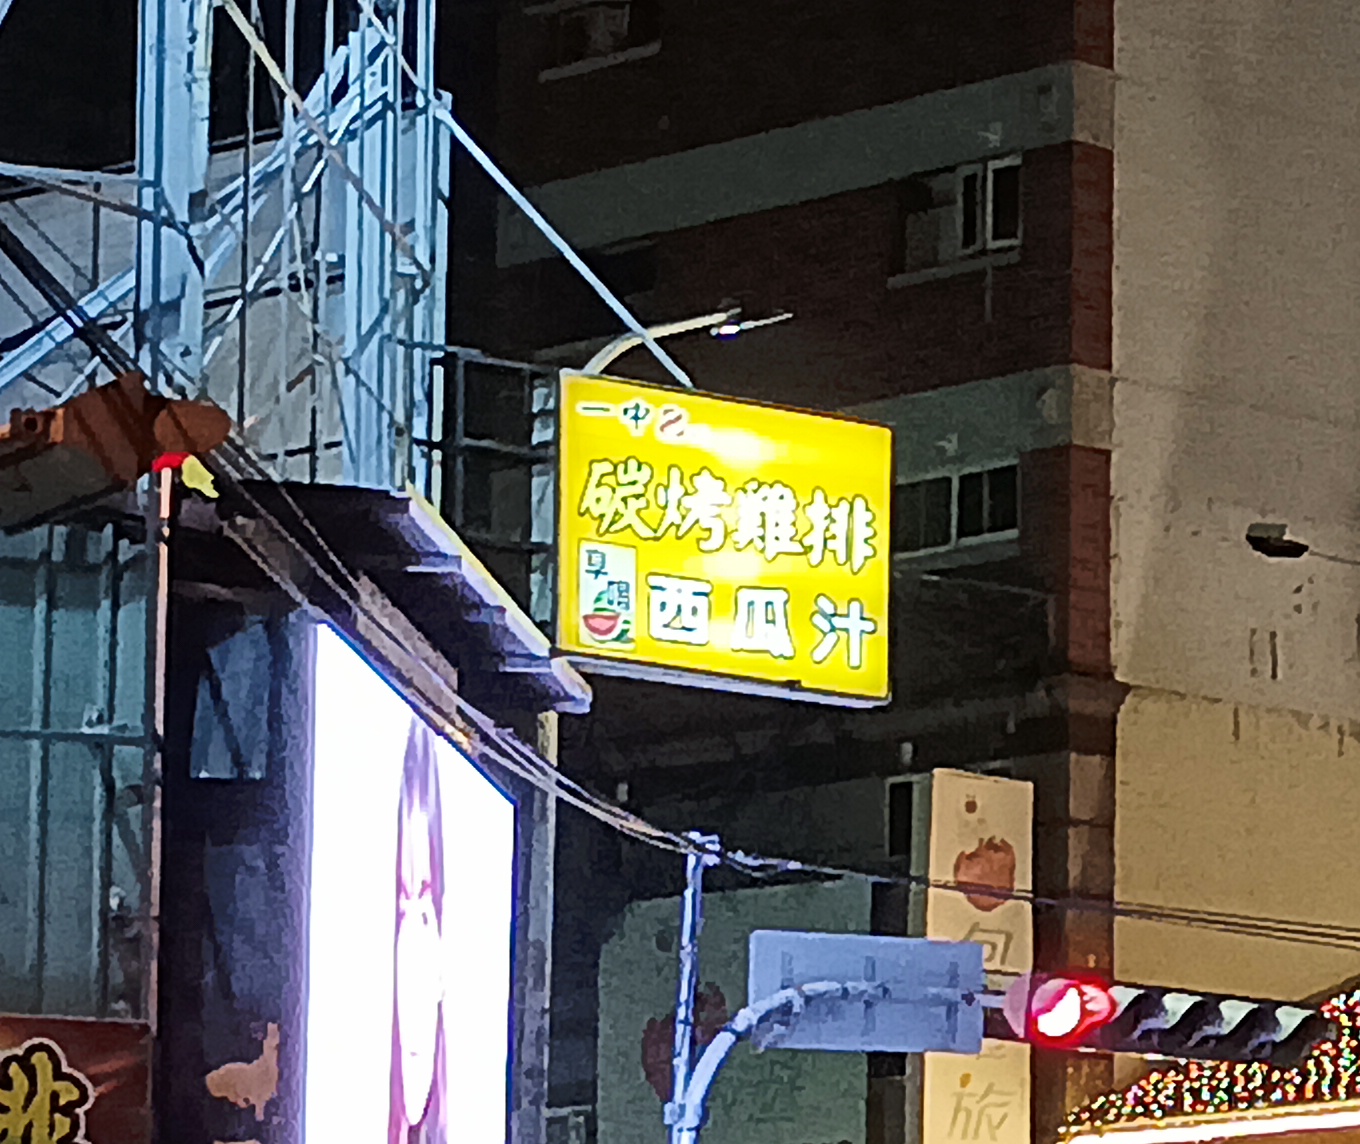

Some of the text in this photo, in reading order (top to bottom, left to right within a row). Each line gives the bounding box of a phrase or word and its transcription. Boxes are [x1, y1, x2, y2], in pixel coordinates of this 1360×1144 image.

[578, 456, 877, 575] 碳烤雞排
[646, 572, 877, 669] 西瓜汁
